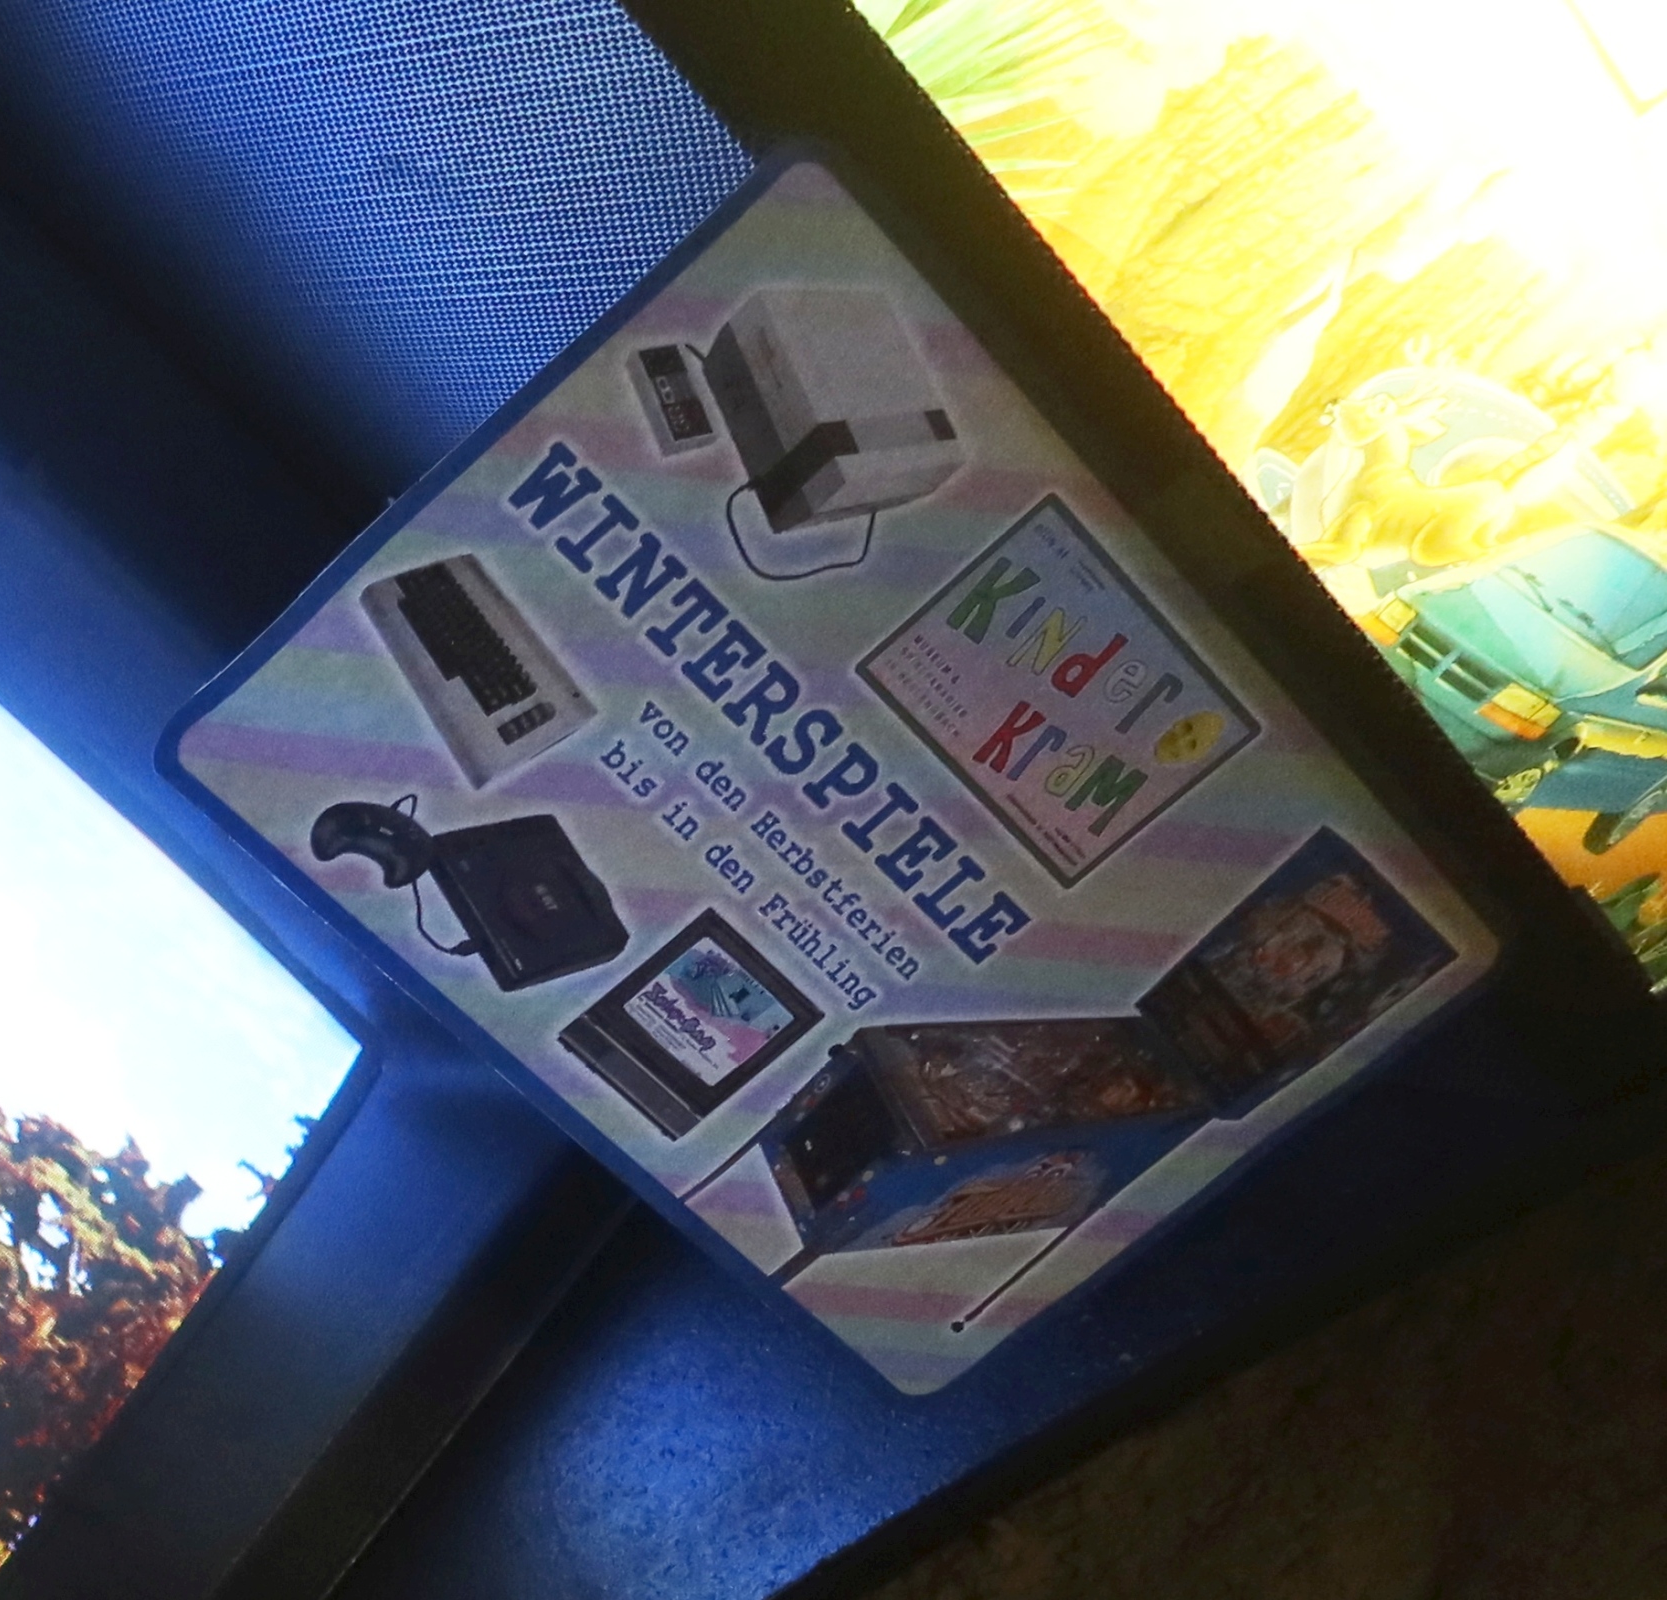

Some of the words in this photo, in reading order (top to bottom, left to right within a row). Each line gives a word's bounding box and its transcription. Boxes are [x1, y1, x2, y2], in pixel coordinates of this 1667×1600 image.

[507, 441, 1033, 966] WINTERSPIELE
[638, 699, 691, 757] von
[695, 758, 748, 813] den
[749, 810, 922, 981] Herbstferien
[600, 739, 658, 800] bis
[662, 803, 694, 843] in
[703, 841, 757, 895] den
[757, 893, 878, 1012] Frühling
